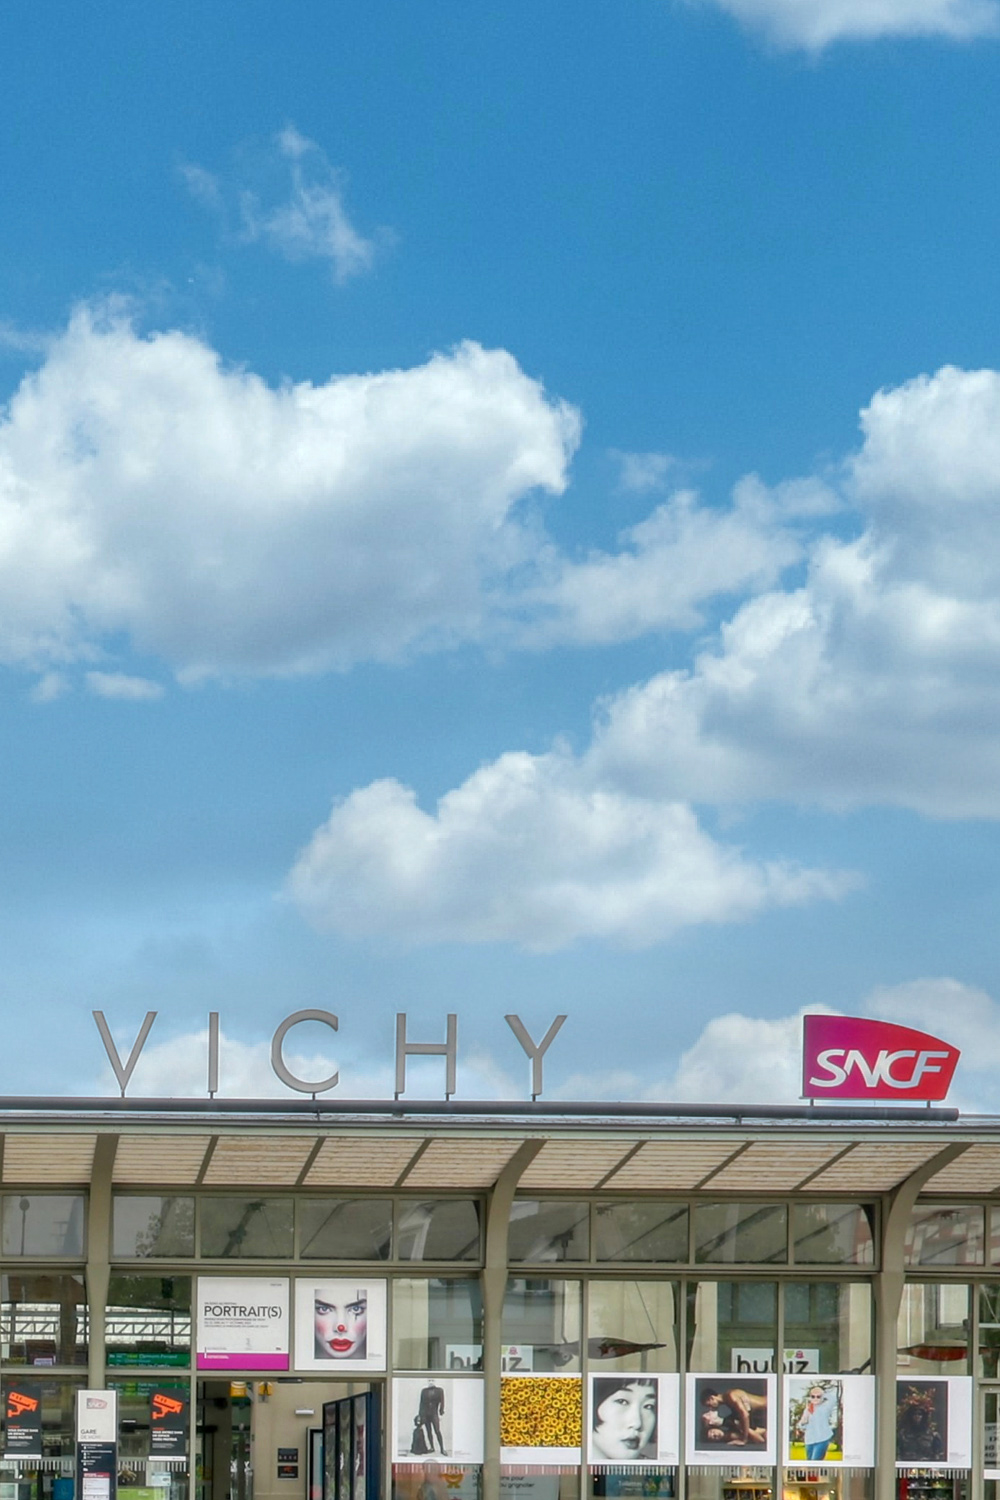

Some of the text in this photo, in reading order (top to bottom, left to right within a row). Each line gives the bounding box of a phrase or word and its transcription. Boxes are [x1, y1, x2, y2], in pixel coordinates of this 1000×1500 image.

[92, 1009, 568, 1095] VICHY
[809, 1048, 950, 1089] SNCF
[204, 1305, 283, 1318] PORTRAIT(S)
